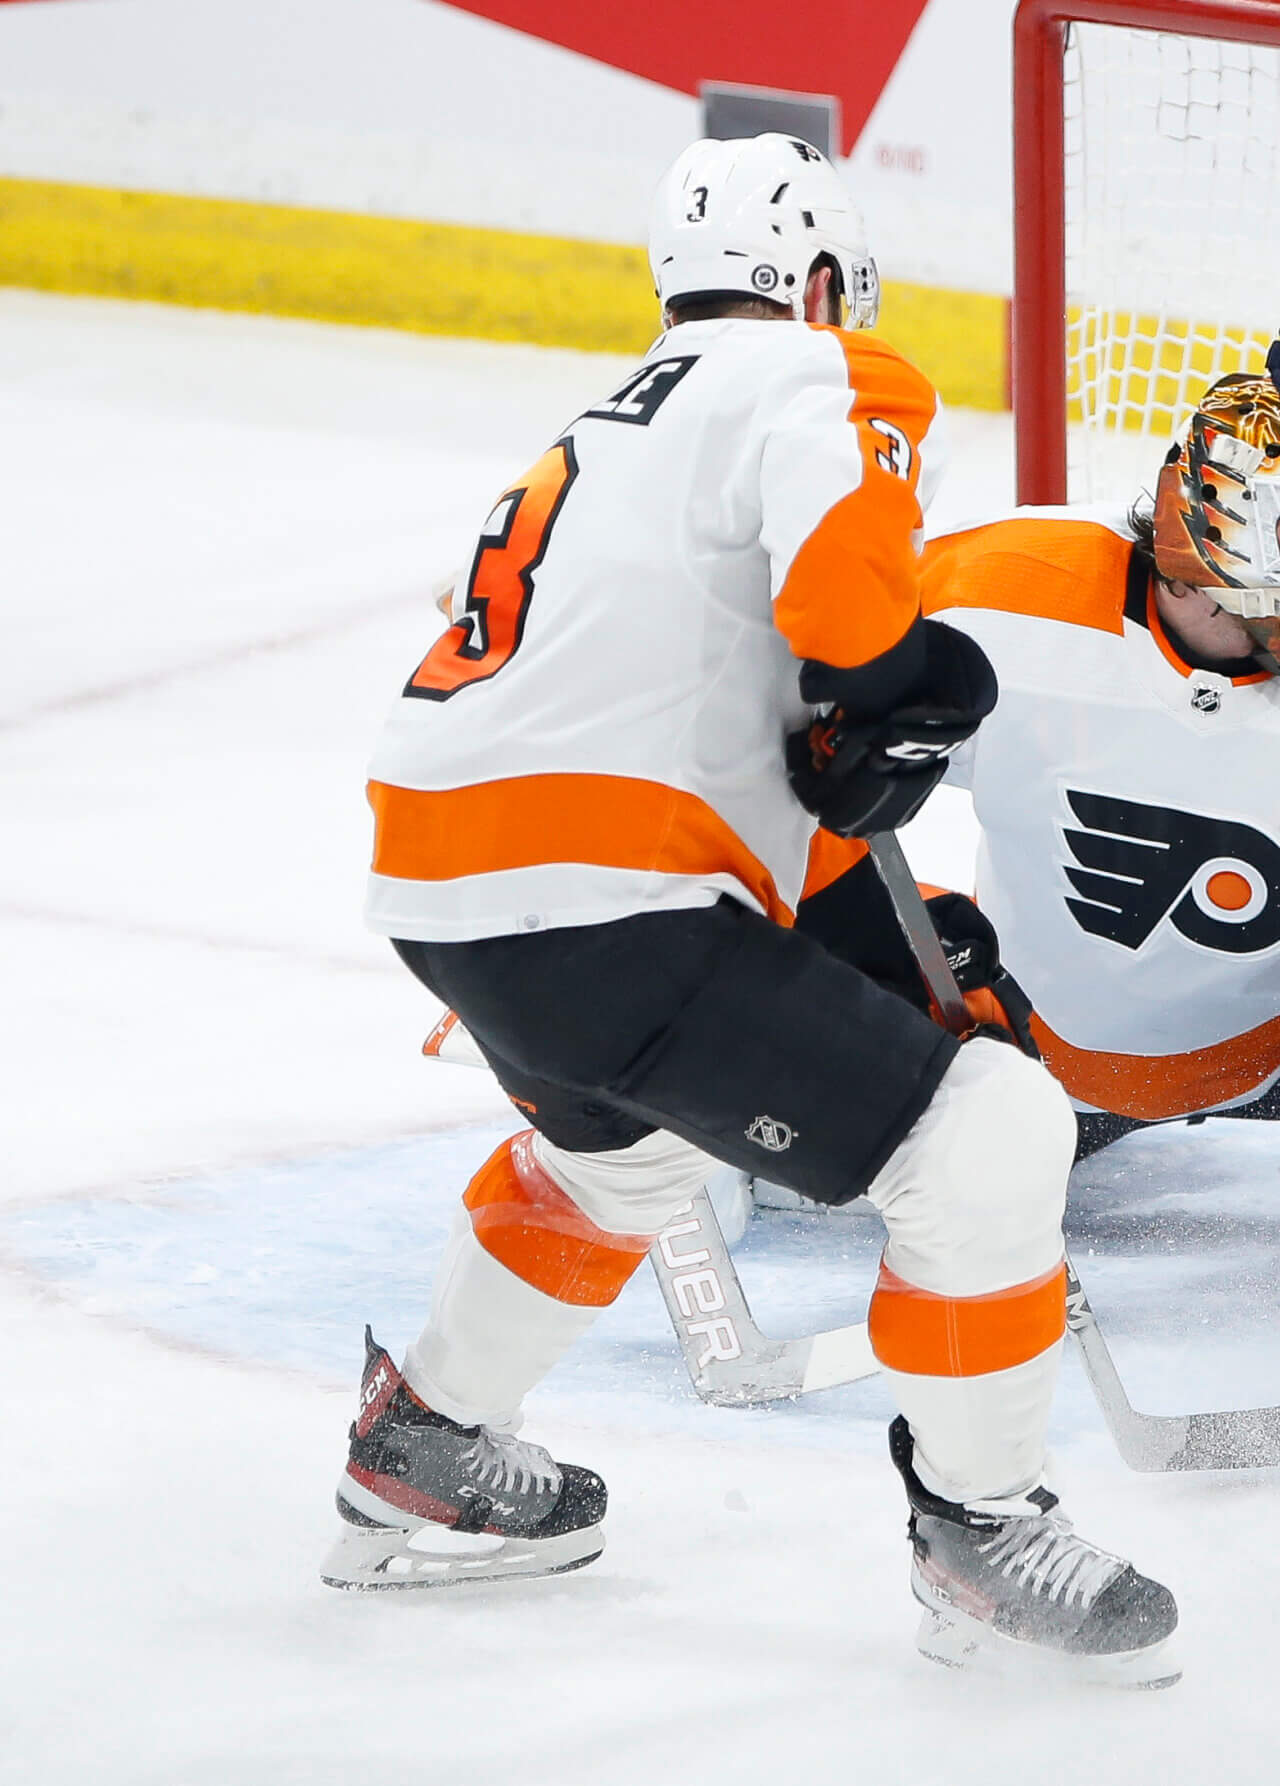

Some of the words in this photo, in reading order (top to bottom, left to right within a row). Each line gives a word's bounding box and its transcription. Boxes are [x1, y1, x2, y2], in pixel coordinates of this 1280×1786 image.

[686, 186, 709, 223] 3
[868, 418, 912, 480] 3
[402, 435, 580, 702] 3
